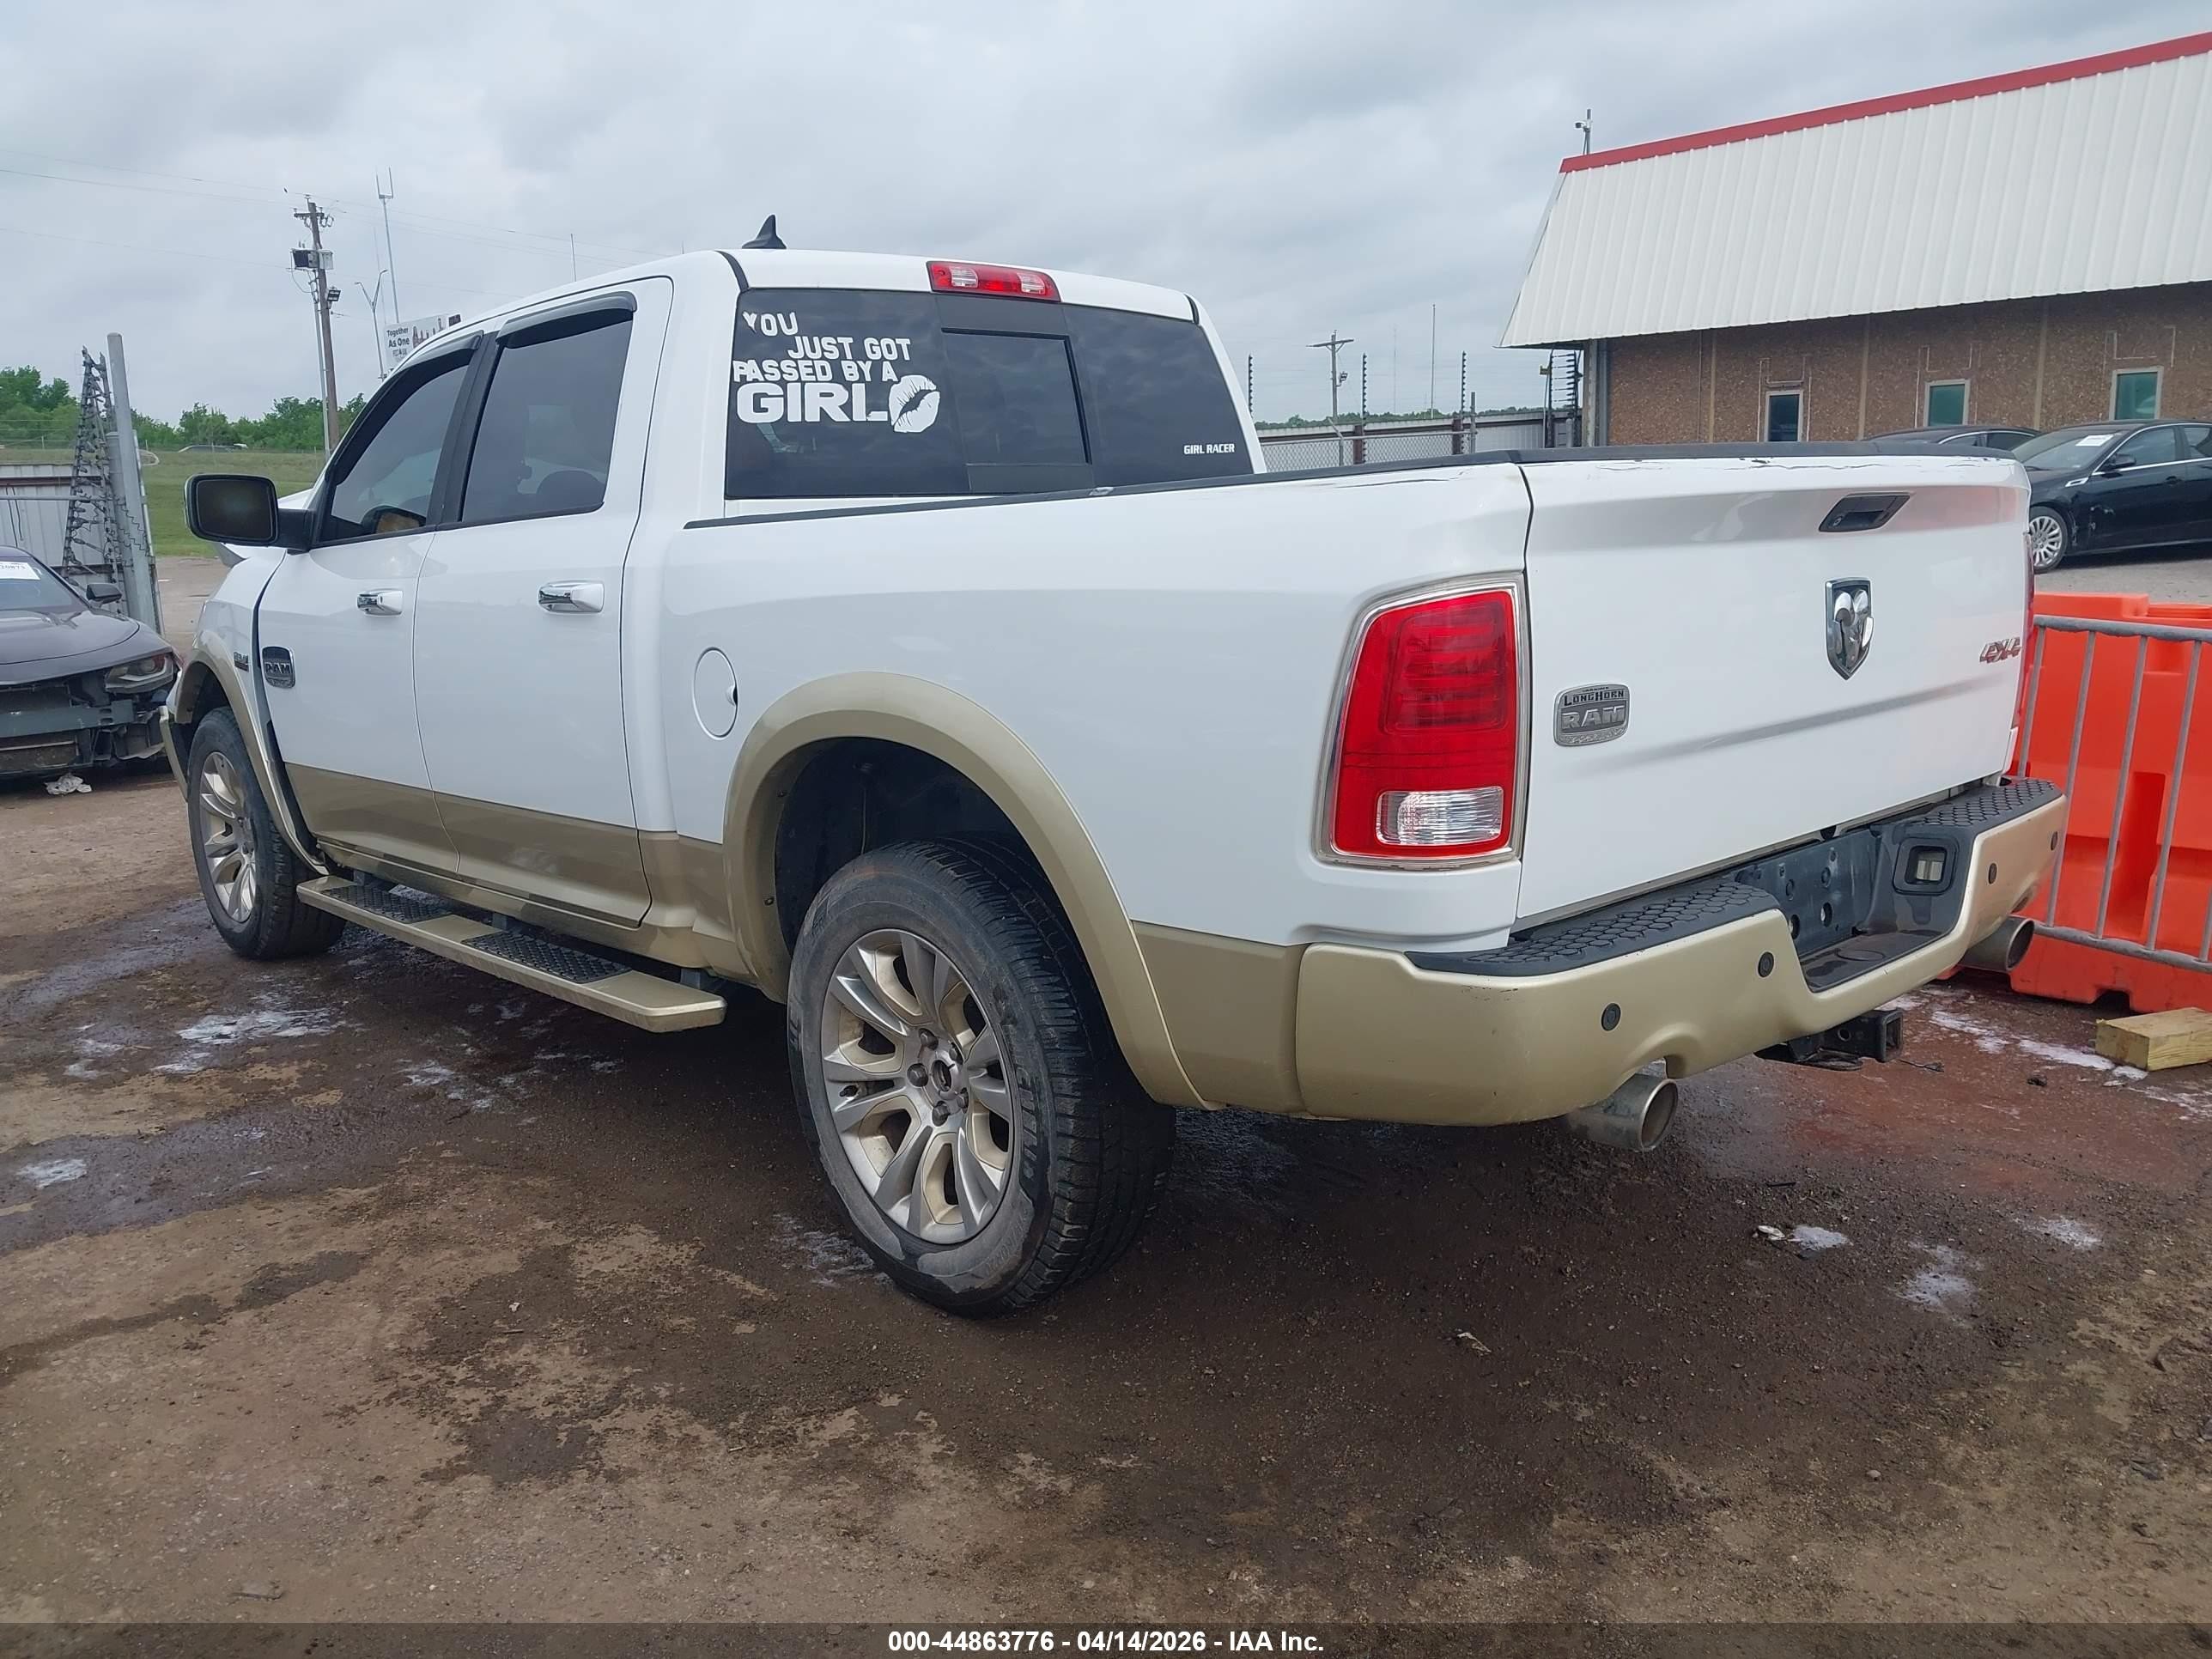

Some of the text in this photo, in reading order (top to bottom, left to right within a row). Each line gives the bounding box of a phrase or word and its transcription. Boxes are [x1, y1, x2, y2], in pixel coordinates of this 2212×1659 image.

[386, 327, 409, 337] Together
[743, 312, 799, 336] YOU
[388, 337, 410, 348] As One
[787, 336, 911, 361] JUST GOT
[732, 359, 899, 382] PASSED BY A
[737, 382, 889, 423] GIRL
[1183, 443, 1236, 454] GIRL RACER
[264, 661, 292, 674] RAM
[1561, 705, 1626, 731] RAM
